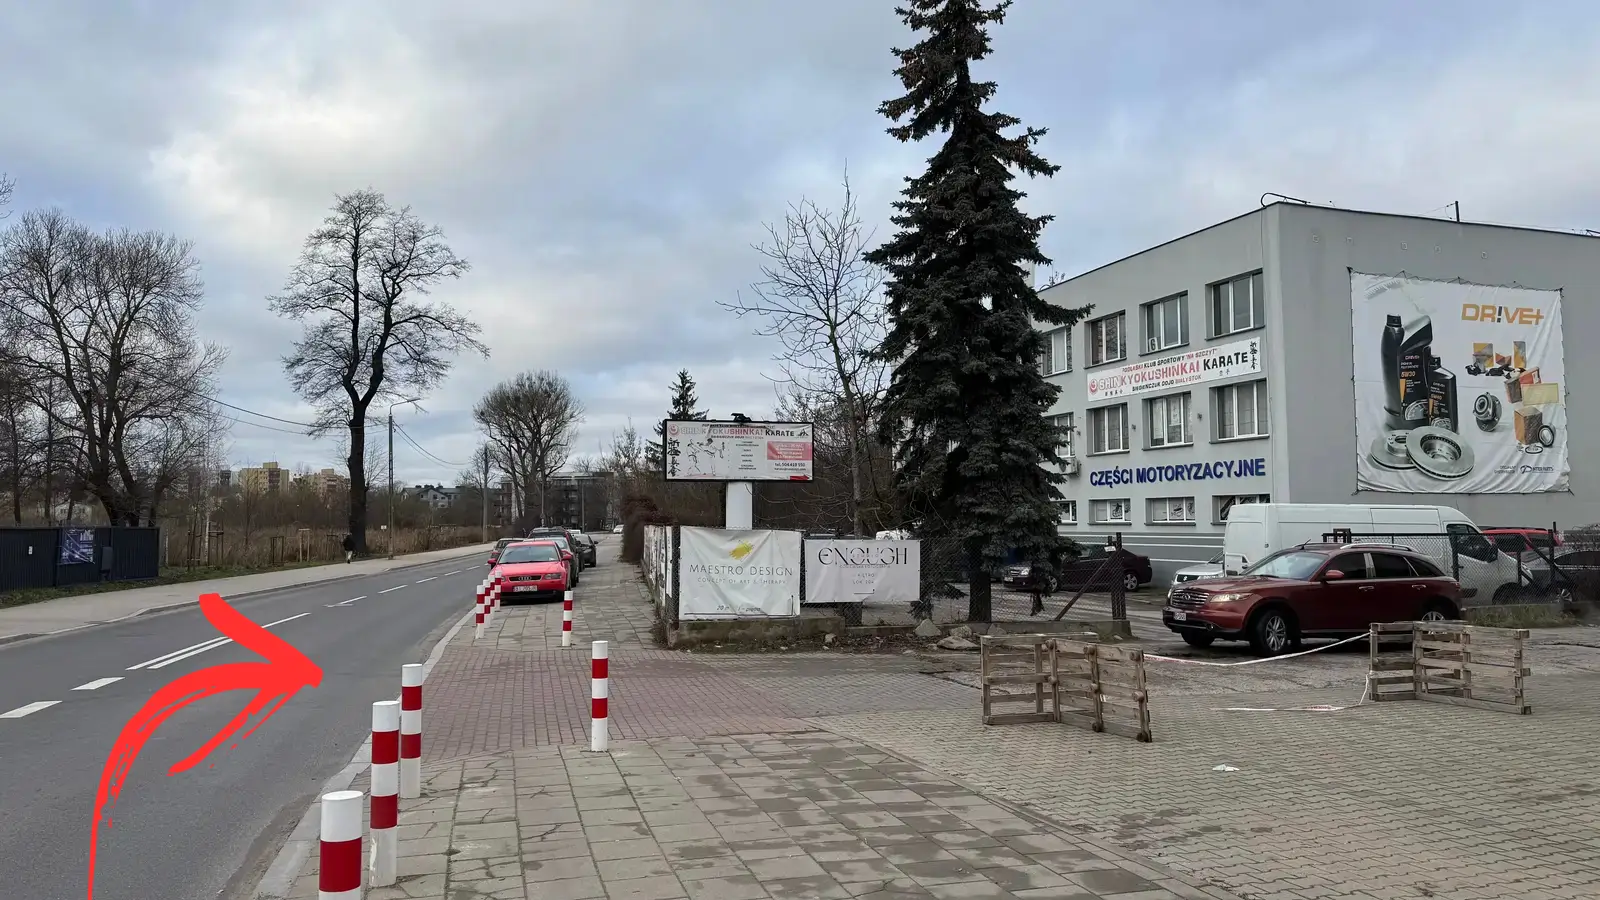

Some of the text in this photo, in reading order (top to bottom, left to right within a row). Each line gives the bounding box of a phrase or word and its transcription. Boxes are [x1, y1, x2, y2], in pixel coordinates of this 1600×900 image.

[1144, 360, 1157, 369] KLUB
[1157, 354, 1185, 366] SPORTOWY
[1203, 351, 1248, 371] KARATE
[1161, 379, 1174, 387] DOJO
[765, 429, 795, 437] KARATE
[1090, 458, 1266, 488] CZĘŚCI MOTORYZACYJNE
[818, 547, 907, 565] ENOUGH
[689, 564, 793, 576] MAESTRO DESIGN
